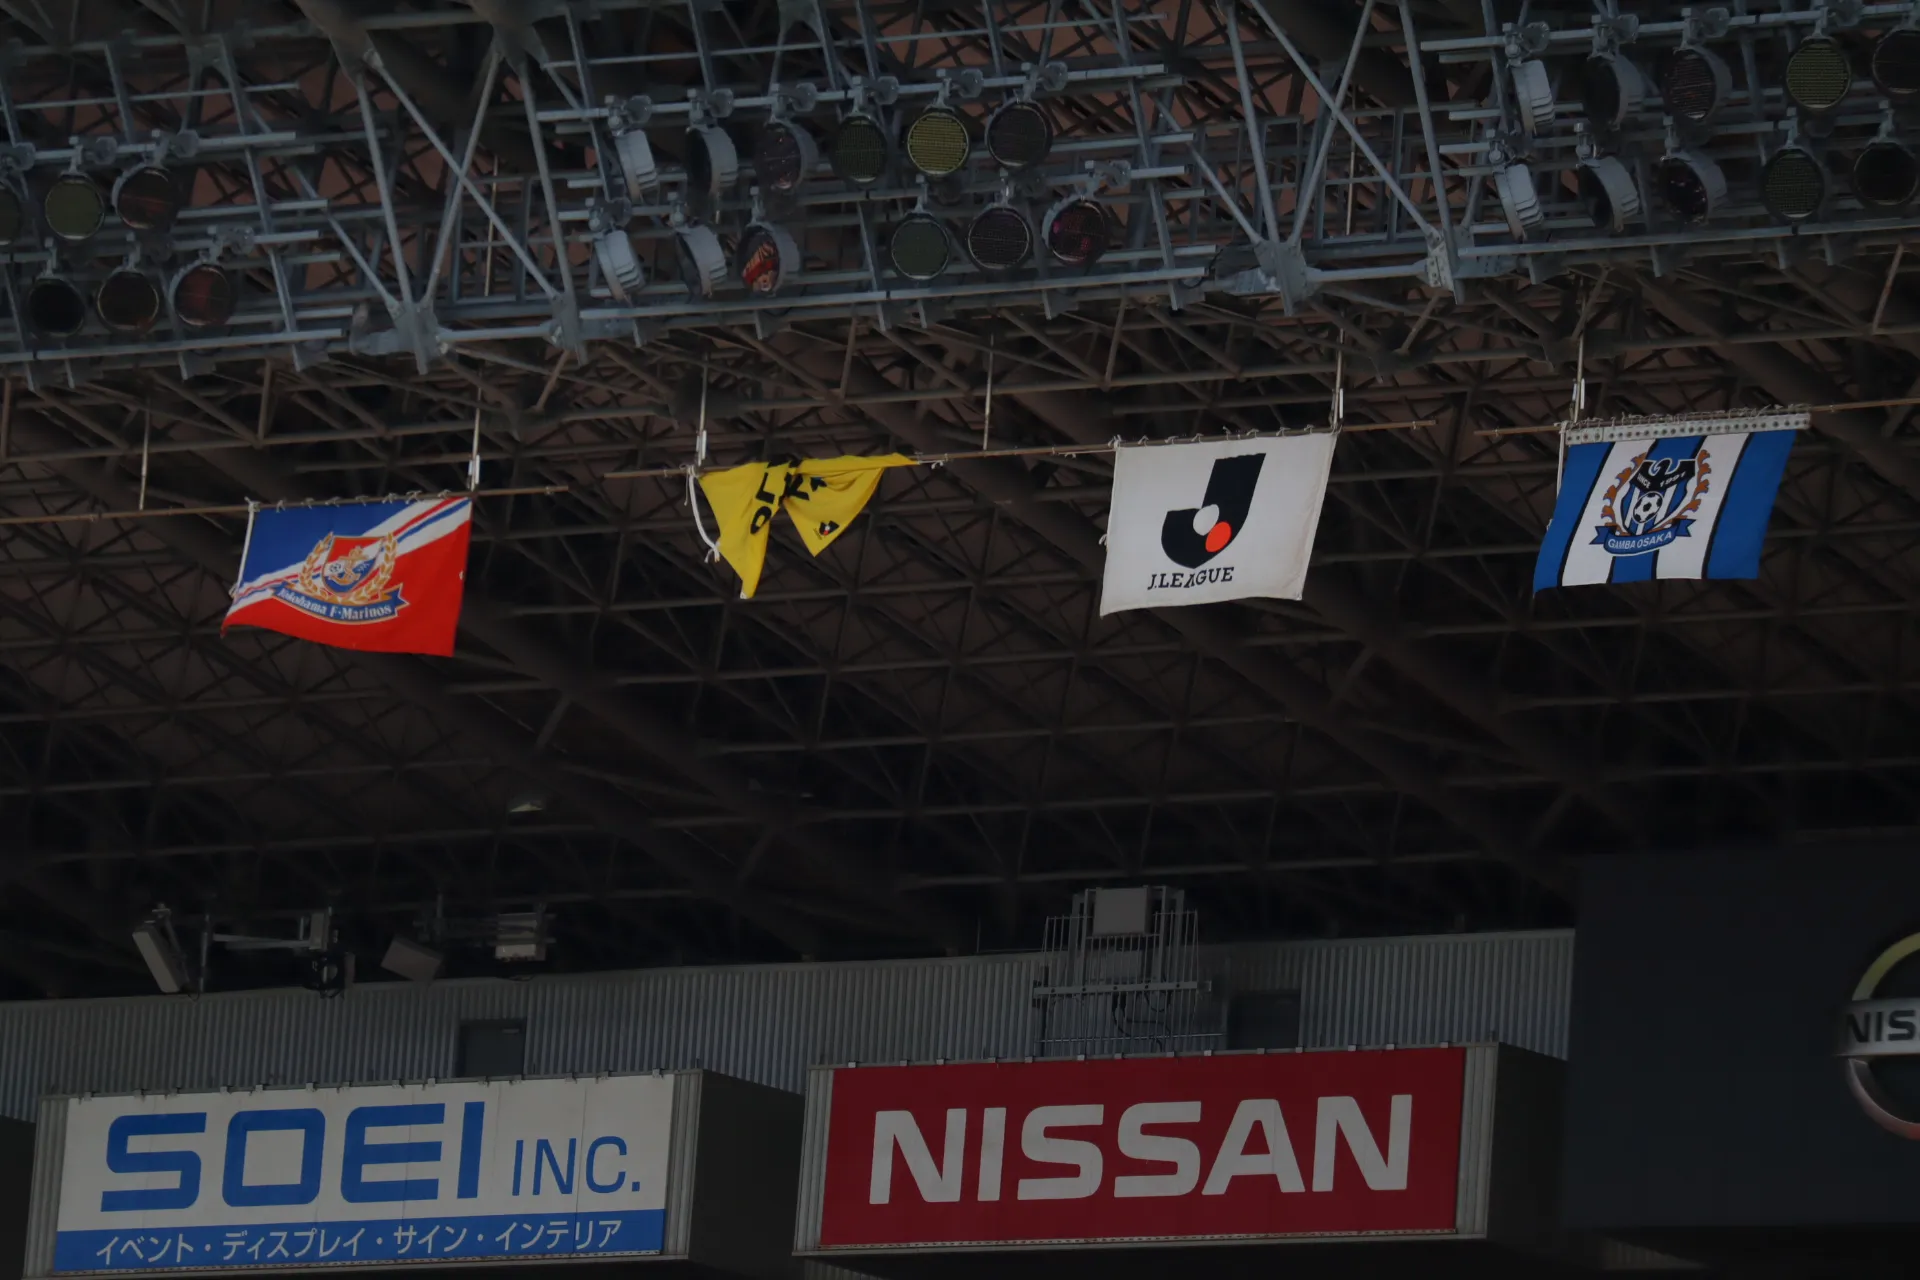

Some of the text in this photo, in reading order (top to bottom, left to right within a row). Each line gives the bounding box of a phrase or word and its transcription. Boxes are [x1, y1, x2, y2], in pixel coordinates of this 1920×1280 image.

[1636, 531, 1672, 548] OSAKA
[1147, 567, 1234, 590] J.LEAGUE
[101, 1101, 641, 1212] SOEI INC.
[869, 1094, 1412, 1204] NISSAN
